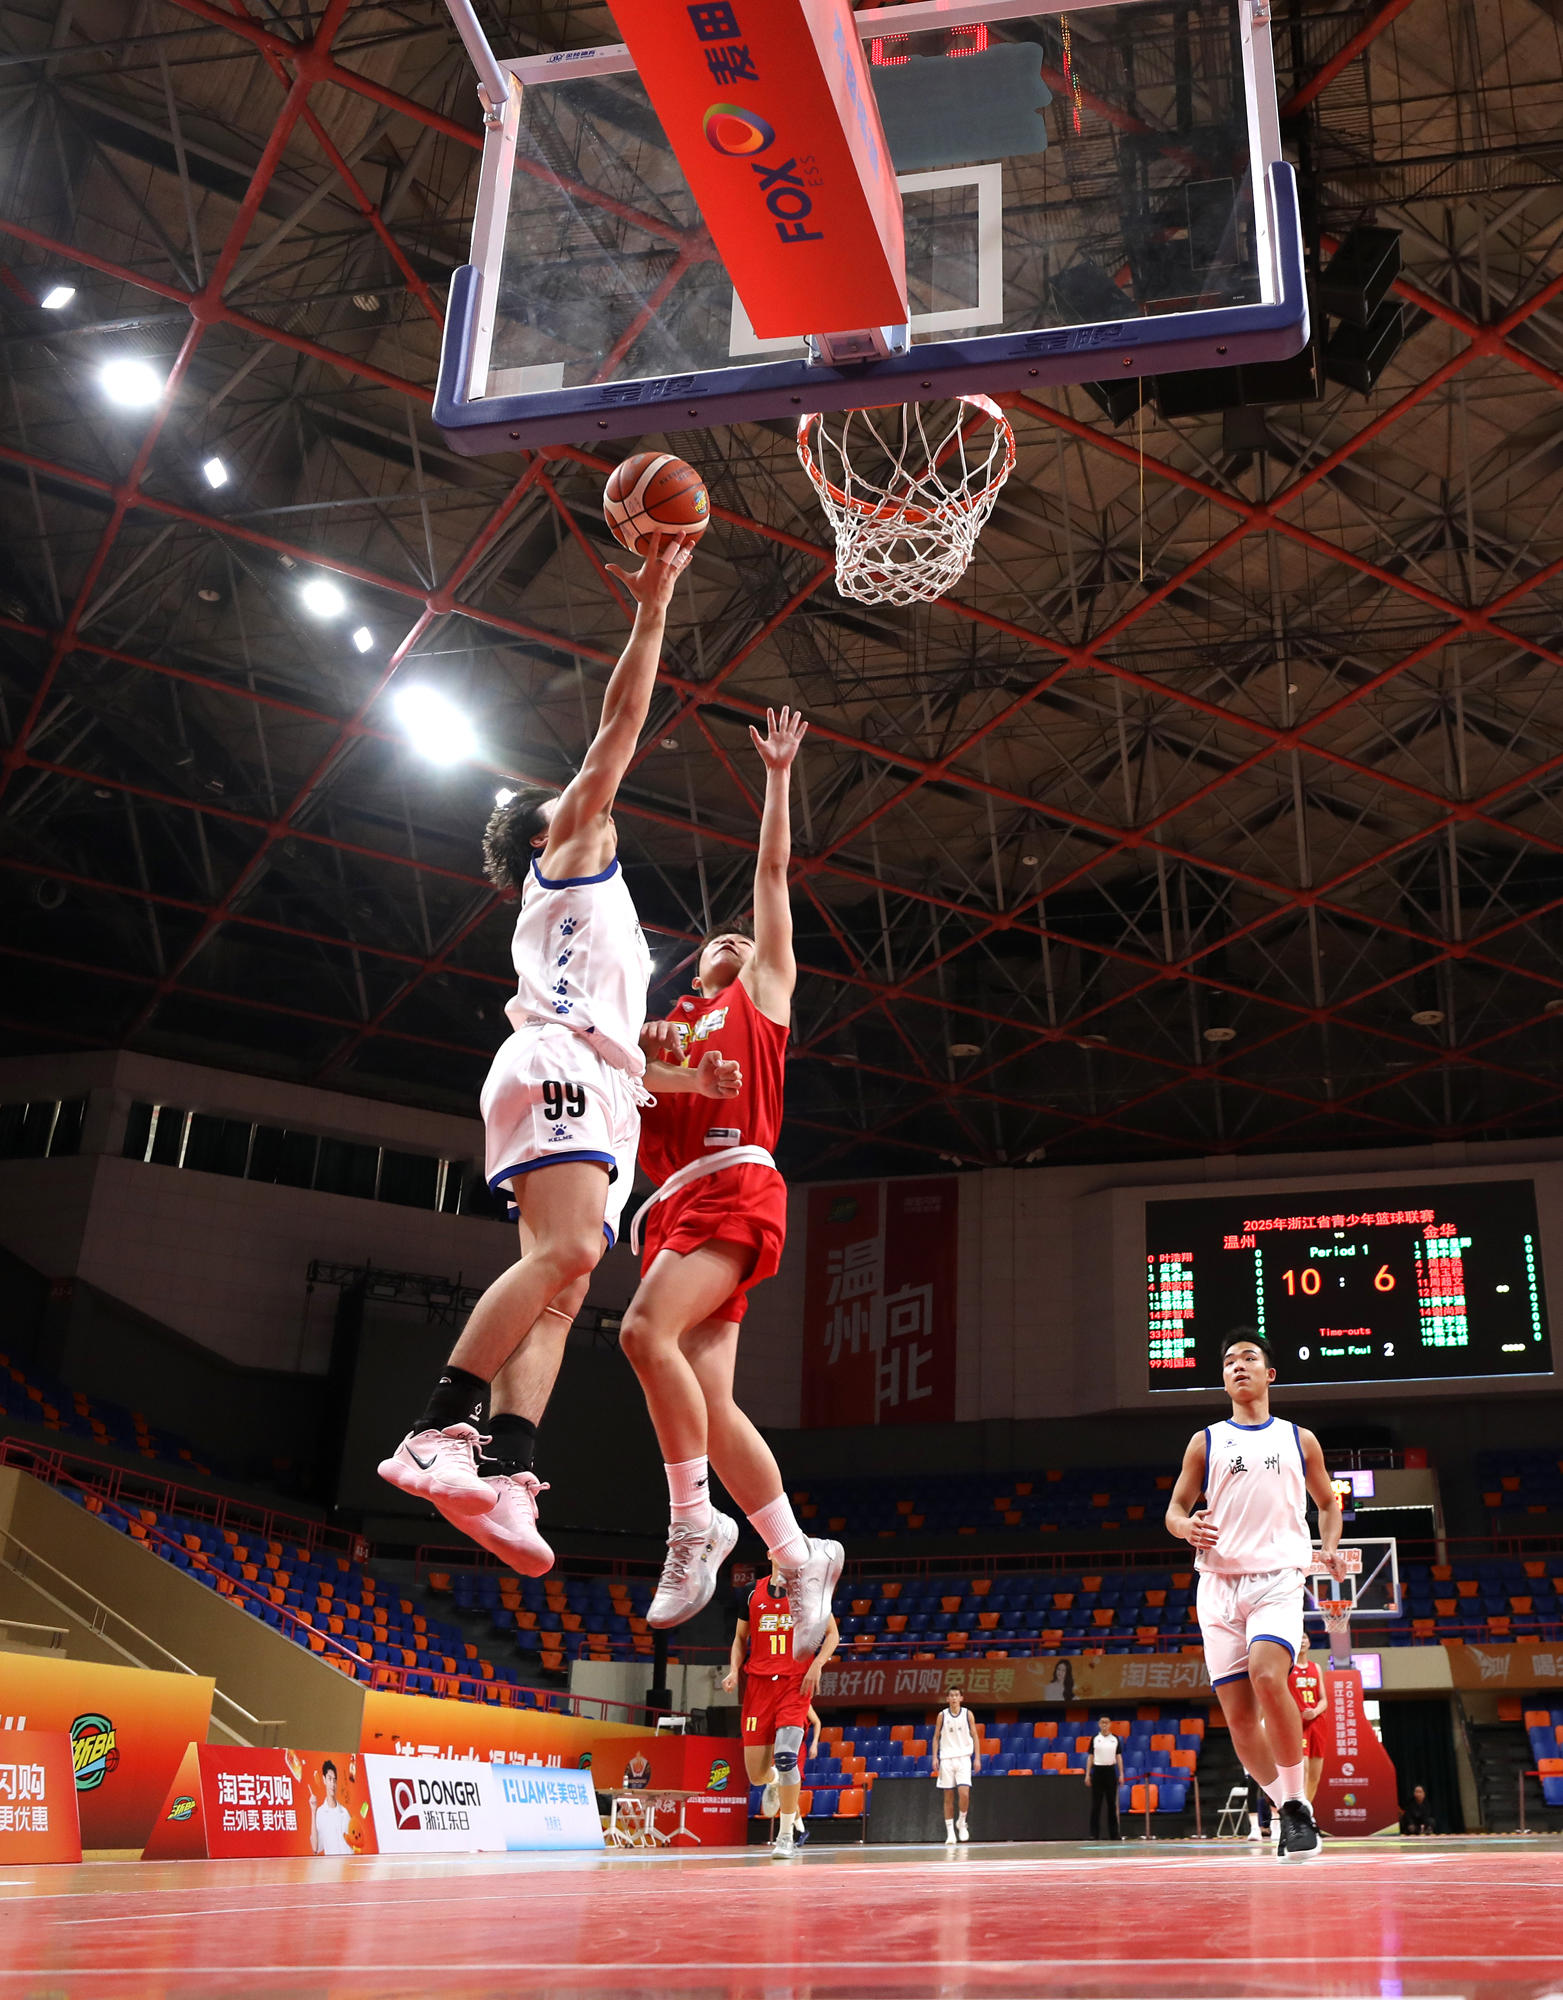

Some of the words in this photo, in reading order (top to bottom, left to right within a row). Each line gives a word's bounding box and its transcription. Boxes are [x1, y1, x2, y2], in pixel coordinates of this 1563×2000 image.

[800, 155, 824, 187] ESS
[751, 158, 824, 243] FOX
[542, 1080, 585, 1120] 99
[548, 1133, 573, 1143] KELME
[1243, 1209, 1434, 1231] 2025年浙江省青少年篮球联赛
[1423, 1223, 1457, 1239] 金华
[1223, 1234, 1256, 1249] 温州
[1524, 1234, 1532, 1244] 0
[1414, 1240, 1420, 1249] 1
[1525, 1244, 1533, 1254] 0
[1255, 1249, 1262, 1258] 0
[1309, 1244, 1356, 1258] Period
[1362, 1244, 1369, 1256] 1
[1414, 1250, 1422, 1260] 2
[1147, 1254, 1155, 1264] 0
[1255, 1258, 1262, 1267] 0
[1415, 1260, 1423, 1268] 4
[1526, 1254, 1534, 1264] 0
[1147, 1264, 1153, 1272] 1
[1255, 1268, 1263, 1277] 0
[1527, 1264, 1535, 1273] 0
[1147, 1273, 1155, 1282] 3
[1416, 1269, 1423, 1278] 7
[1528, 1274, 1536, 1283] 0
[1256, 1277, 1263, 1286] 4
[1281, 1267, 1321, 1296] 10
[1373, 1264, 1396, 1292] 6
[1417, 1278, 1428, 1288] 11
[1147, 1282, 1155, 1291] 4
[1256, 1286, 1264, 1296] 0
[1529, 1283, 1537, 1293] 4
[1148, 1292, 1159, 1301] 11
[1418, 1288, 1430, 1298] 12
[1530, 1293, 1538, 1303] 0
[824, 1237, 886, 1366] 温州
[1149, 1301, 1160, 1310] 13
[1257, 1296, 1264, 1305] 0
[1418, 1298, 1431, 1307] 13
[1257, 1305, 1265, 1315] 2
[1419, 1307, 1432, 1317] 14
[1531, 1303, 1539, 1312] 2
[1149, 1311, 1160, 1319] 14
[1258, 1315, 1265, 1325] 0
[1532, 1313, 1540, 1322] 0
[1149, 1320, 1161, 1329] 23
[1420, 1317, 1432, 1327] 17
[1258, 1325, 1266, 1334] 4
[1319, 1326, 1372, 1337] Time-outs
[1421, 1327, 1433, 1337] 18
[1533, 1323, 1541, 1332] 0
[1149, 1330, 1161, 1339] 33
[1534, 1332, 1542, 1342] 0
[870, 1283, 933, 1407] 向北
[1149, 1339, 1161, 1348] 45
[1421, 1337, 1434, 1347] 19
[1149, 1349, 1161, 1359] 88
[1299, 1345, 1310, 1360] 0
[1320, 1346, 1345, 1357] Team
[1347, 1345, 1371, 1356] Foul
[1383, 1342, 1395, 1357] 2
[1150, 1359, 1161, 1368] 99
[1229, 1453, 1281, 1476] 温州
[759, 1614, 793, 1631] 金华
[770, 1634, 786, 1655] 11
[1302, 1690, 1315, 1703] 12
[746, 1717, 758, 1732] 11
[217, 1772, 293, 1806] 淘宝闪购
[418, 1779, 482, 1807] DONGRI
[548, 1780, 590, 1806] 华美电梯
[222, 1809, 260, 1831] 点外卖
[262, 1809, 298, 1832] 更优惠
[424, 1810, 470, 1831] 浙江东日
